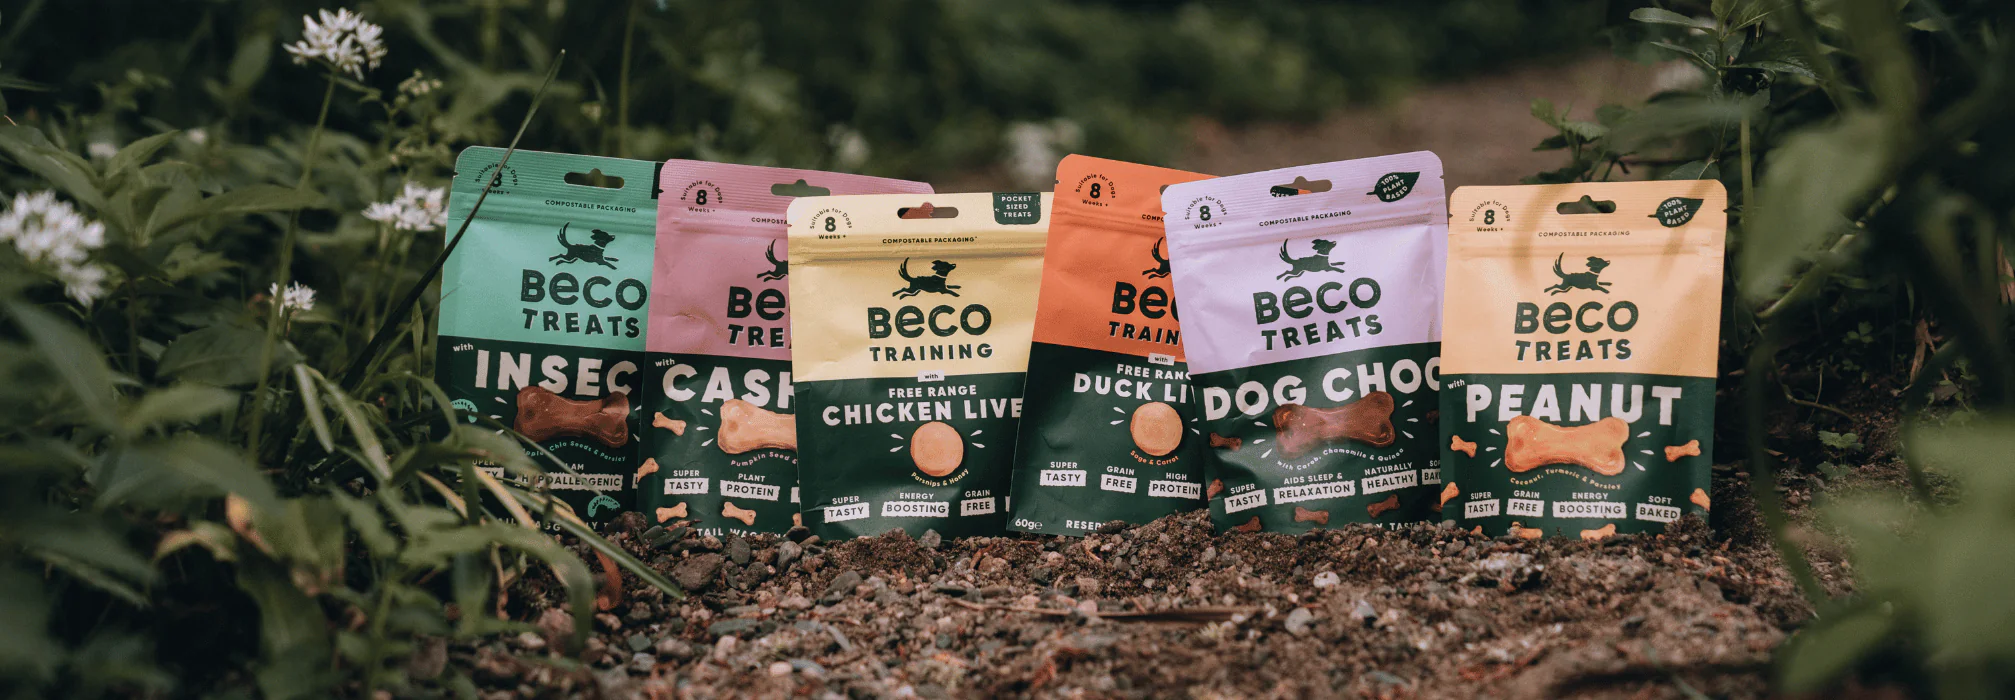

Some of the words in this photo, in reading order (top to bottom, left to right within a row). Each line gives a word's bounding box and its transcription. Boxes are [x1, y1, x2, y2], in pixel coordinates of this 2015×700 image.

[1076, 173, 1096, 193] Suitable
[1099, 174, 1108, 182] for
[1381, 174, 1399, 186] 100%
[1382, 179, 1405, 193] PLANT
[681, 180, 703, 200] Suitable
[1090, 182, 1101, 199] 8
[1386, 186, 1408, 200] BASED
[696, 190, 707, 206] 8
[1664, 198, 1682, 210] 100%
[545, 200, 595, 210] COMPOSTABLE
[597, 204, 637, 213] PACKAGING
[1184, 196, 1202, 220] Suitable
[1216, 200, 1228, 216] Dogs
[1200, 205, 1212, 221] 8
[1469, 200, 1490, 222] Suitable
[1502, 206, 1510, 222] Dogs
[1664, 204, 1688, 218] PLANT
[810, 208, 830, 229] Suitable
[842, 212, 852, 229] Dogs
[825, 216, 836, 232] 8
[1259, 215, 1309, 227] COMPOSTABLE
[1310, 210, 1352, 222] PACKAGING
[1484, 209, 1495, 225] 8
[1666, 212, 1690, 224] BASED
[520, 269, 648, 311] Beco
[726, 286, 786, 321] Be
[1253, 277, 1382, 325] Beco
[522, 308, 641, 338] TREATS
[868, 304, 992, 339] Beco
[1514, 300, 1639, 335] Beco
[727, 324, 791, 349] TRE
[1108, 321, 1180, 346] TRAIN
[1261, 314, 1382, 350] TREATS
[453, 343, 474, 352] with
[869, 343, 993, 362] TRAINING
[1515, 338, 1632, 362] TREATS
[654, 358, 675, 367] with
[475, 350, 638, 396] INSEC
[1116, 364, 1150, 378] FREE
[889, 388, 922, 398] FREE
[927, 384, 977, 396] RANGE
[1073, 372, 1152, 400] DUCK
[1164, 384, 1195, 404] LI
[1448, 378, 1466, 390] with
[1203, 375, 1307, 421] DOG
[1466, 384, 1682, 426] PEANUT
[822, 400, 952, 426] CHICKEN
[964, 398, 1023, 420] LIVE
[570, 440, 592, 452] Seeds
[600, 453, 626, 462] Parsley
[1130, 450, 1147, 464] Sage
[1156, 456, 1179, 466] Carrot
[731, 454, 766, 467] Pumpkin
[769, 452, 790, 461] Seed
[1277, 460, 1294, 471] with
[1323, 448, 1366, 459] Chamomile
[1378, 448, 1404, 462] Quinoa
[1106, 466, 1135, 476] GRAIN
[1364, 462, 1413, 476] NATURALLY
[1424, 472, 1440, 480] BAK
[522, 474, 620, 486] HPOALLEGENIC
[738, 474, 766, 482] PLANT
[911, 472, 940, 488] Parsnips
[949, 468, 969, 484] Honey
[1046, 473, 1081, 482] TASTY
[1106, 478, 1132, 489] FREE
[1166, 472, 1187, 481] HIGH
[1284, 476, 1305, 486] AIDS
[1308, 472, 1334, 482] SLEEP
[1336, 472, 1342, 480] &
[1367, 474, 1414, 489] HEALTHY
[1510, 474, 1544, 486] Coconut,
[1546, 468, 1580, 479] Turmeric
[1589, 478, 1620, 490] Parsley
[670, 482, 703, 490] TASTY
[726, 484, 774, 496] PROTEIN
[1152, 484, 1199, 495] PROTEIN
[1230, 483, 1256, 494] SUPER
[1279, 484, 1350, 499] RELAXATION
[832, 496, 860, 505] SUPER
[965, 490, 991, 498] GRAIN
[1230, 494, 1262, 508] TASTY
[1470, 492, 1492, 500] SUPER
[1514, 490, 1540, 499] GRAIN
[1648, 495, 1672, 505] SOFT
[829, 506, 864, 518] TASTY
[886, 504, 946, 514] BOOSTING
[966, 502, 991, 512] FREE
[1468, 503, 1496, 514] TASTY
[1512, 502, 1537, 512] FREE
[1559, 504, 1622, 514] BOOSTING
[1640, 507, 1678, 519] BAKED
[697, 528, 724, 536] TAIL
